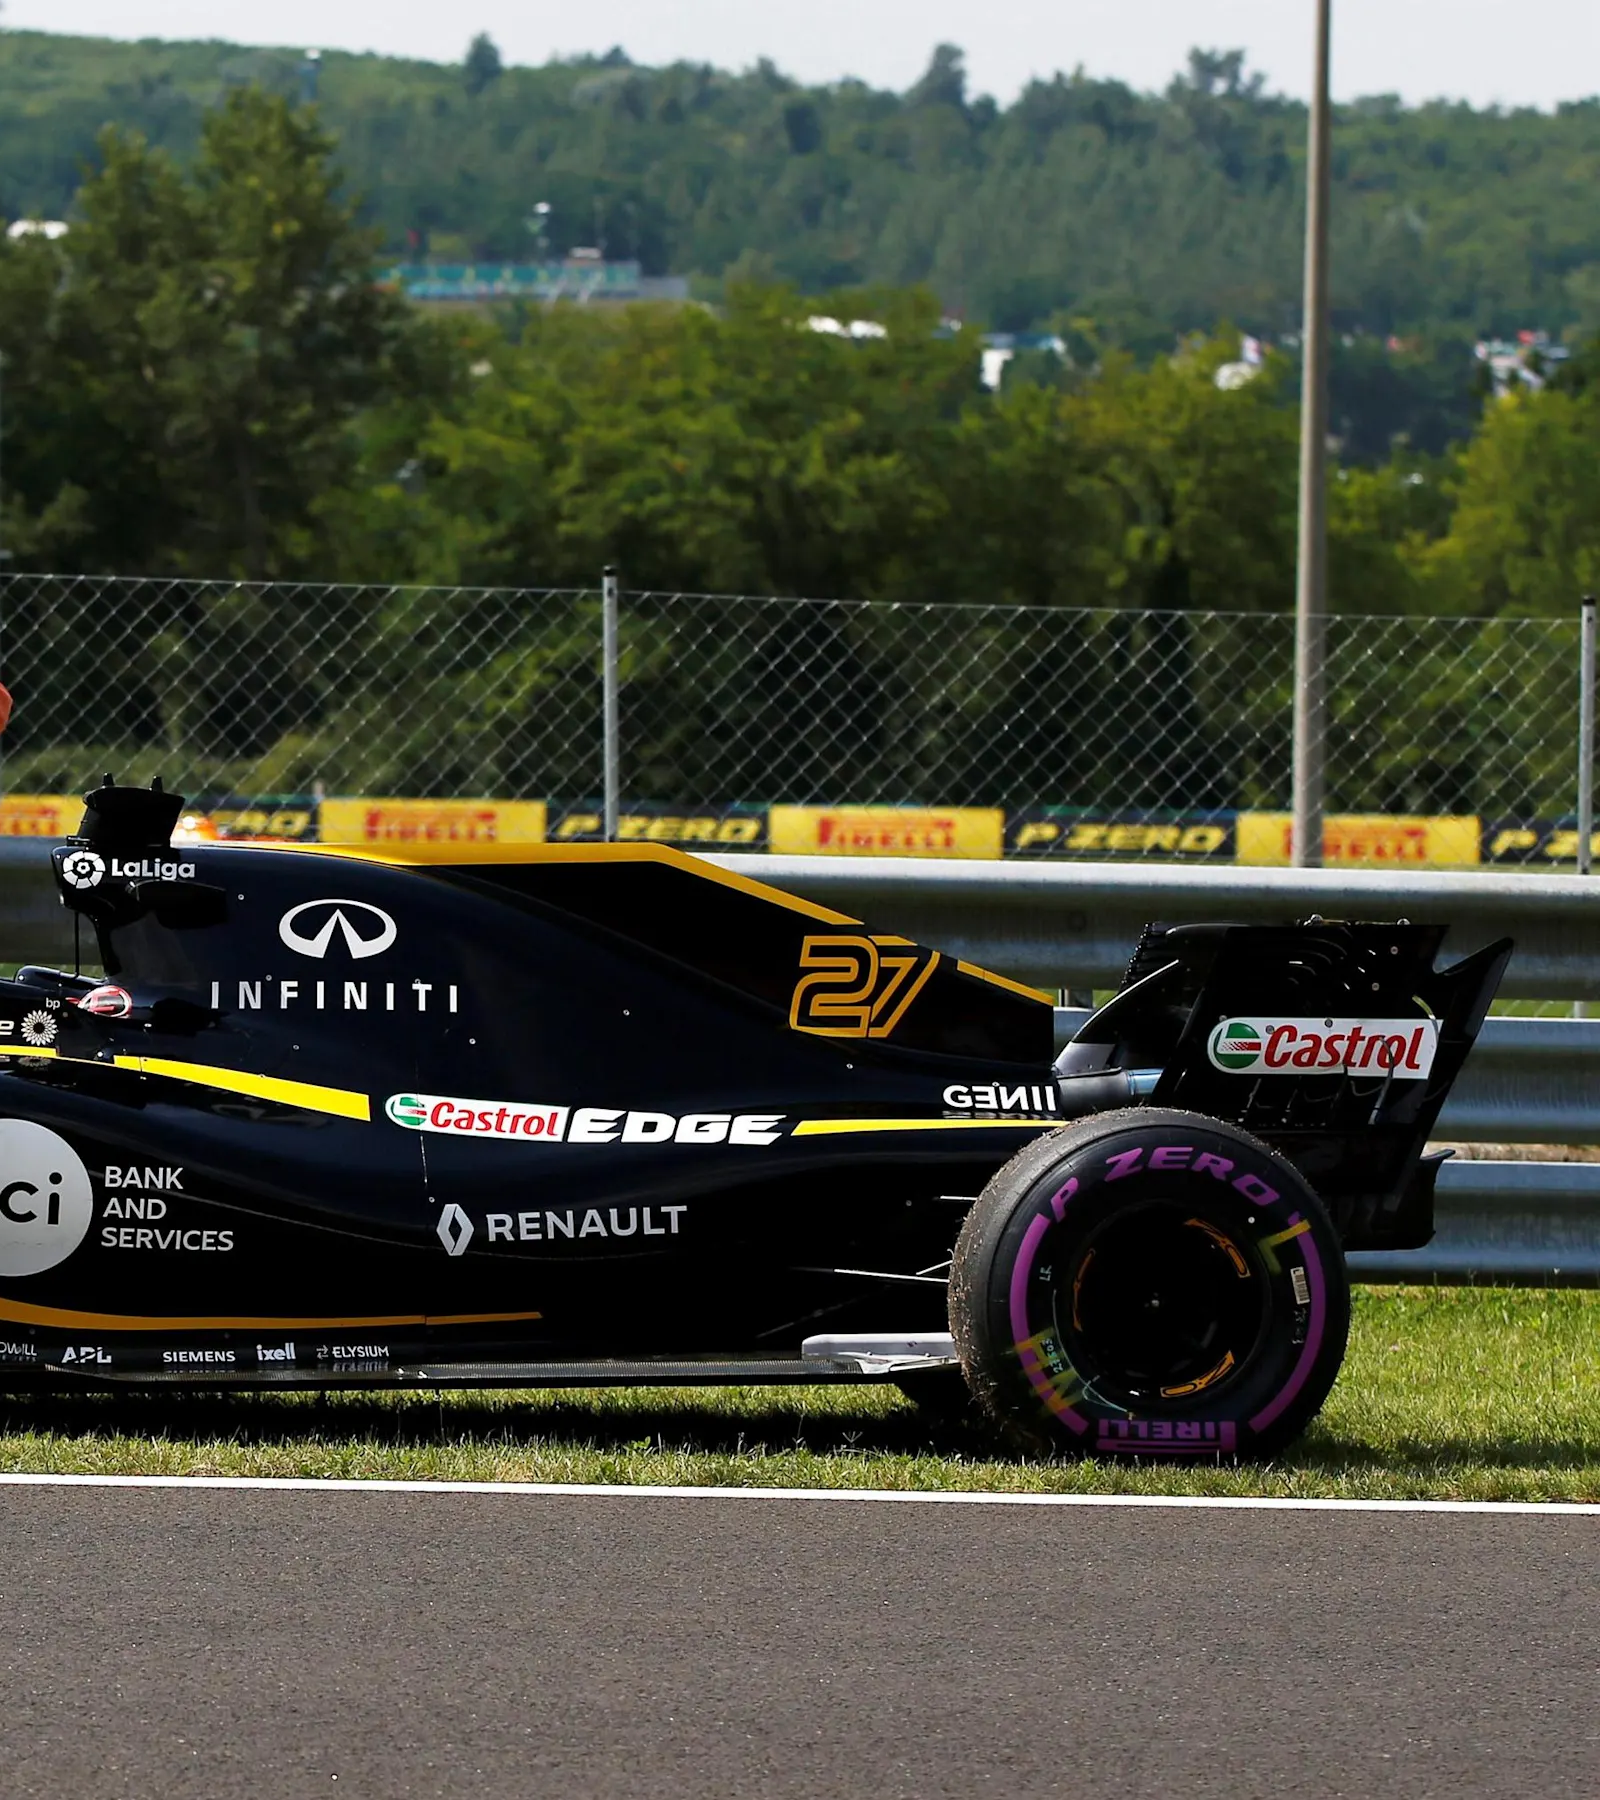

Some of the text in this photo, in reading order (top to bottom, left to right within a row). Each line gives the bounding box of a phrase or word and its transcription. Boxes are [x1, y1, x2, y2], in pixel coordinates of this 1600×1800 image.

[365, 810, 497, 842] PIRELLI
[557, 813, 761, 843] P ZERO
[818, 816, 956, 850] PIRELLI
[1014, 821, 1226, 852] P ZERO
[111, 858, 196, 879] LaLiga
[210, 980, 458, 1013] INFINITI
[789, 935, 941, 1038] 27
[45, 998, 61, 1010] bp
[1264, 1024, 1425, 1070] Castrol
[431, 1100, 788, 1146] Castrol EDGE
[104, 1166, 184, 1190] BANK
[1051, 1147, 1280, 1223] P ZERO
[102, 1197, 167, 1220] AND
[485, 1205, 688, 1243] RENAULT
[101, 1227, 235, 1252] SERVICES
[163, 1349, 237, 1363] SIEMENS
[256, 1342, 297, 1362] ixell
[332, 1345, 390, 1359] ELYSIUM
[1095, 1419, 1237, 1454] PIRELLI
